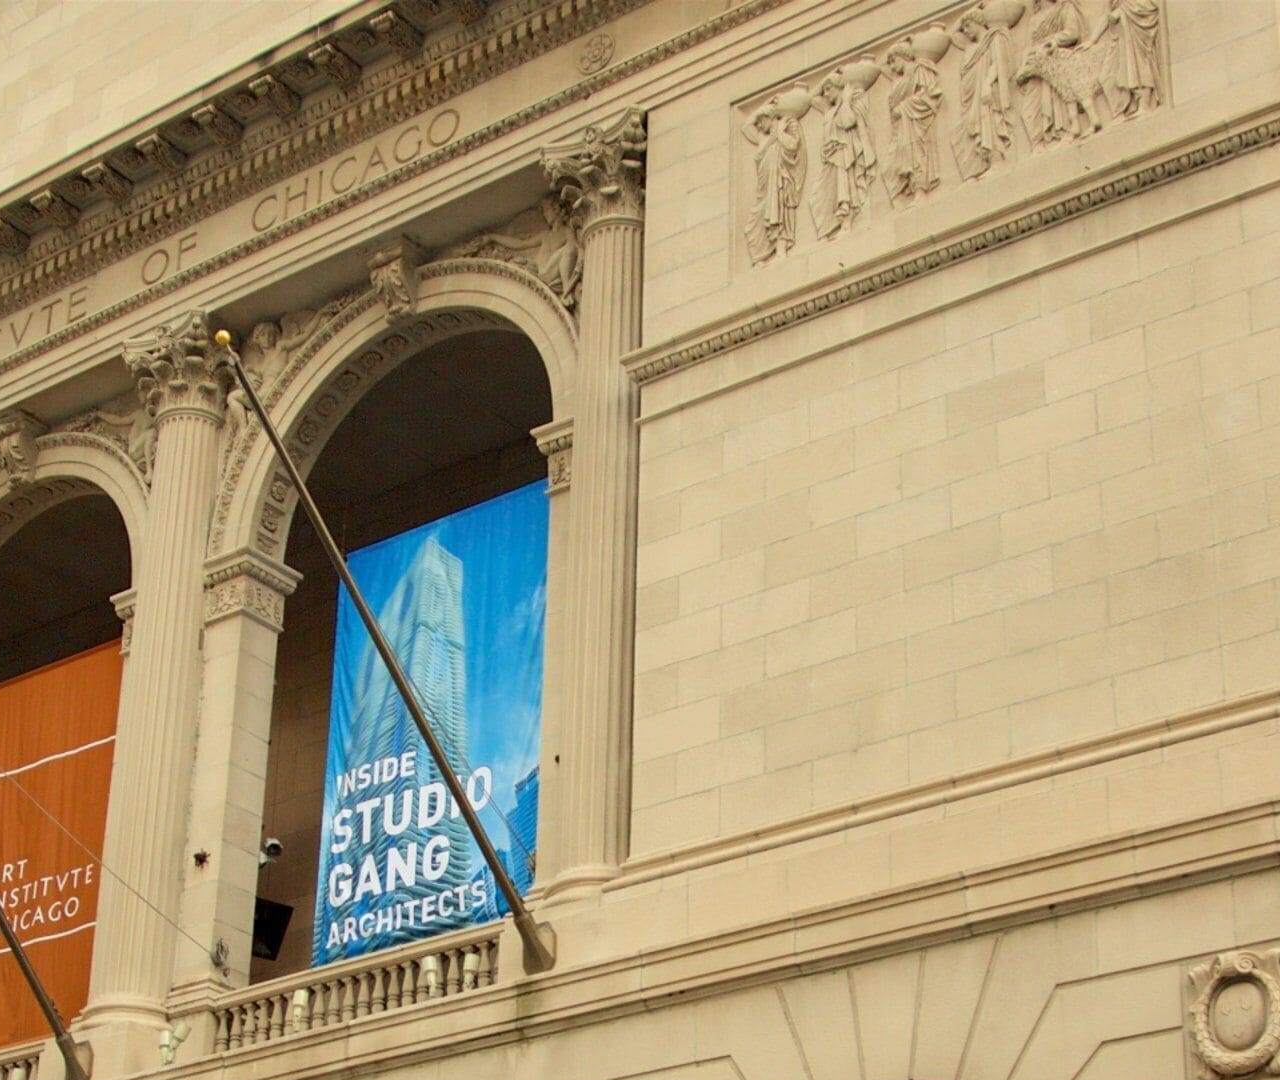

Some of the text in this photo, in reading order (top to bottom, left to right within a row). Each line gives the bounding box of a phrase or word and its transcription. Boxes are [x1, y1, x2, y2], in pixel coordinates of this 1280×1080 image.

[141, 231, 197, 285] OF
[251, 108, 460, 233] CHICAGO
[330, 765, 493, 855] STUDIO
[336, 750, 417, 798] INSIDE
[328, 834, 451, 908] GANG
[325, 879, 487, 949] ARCHITECTS
